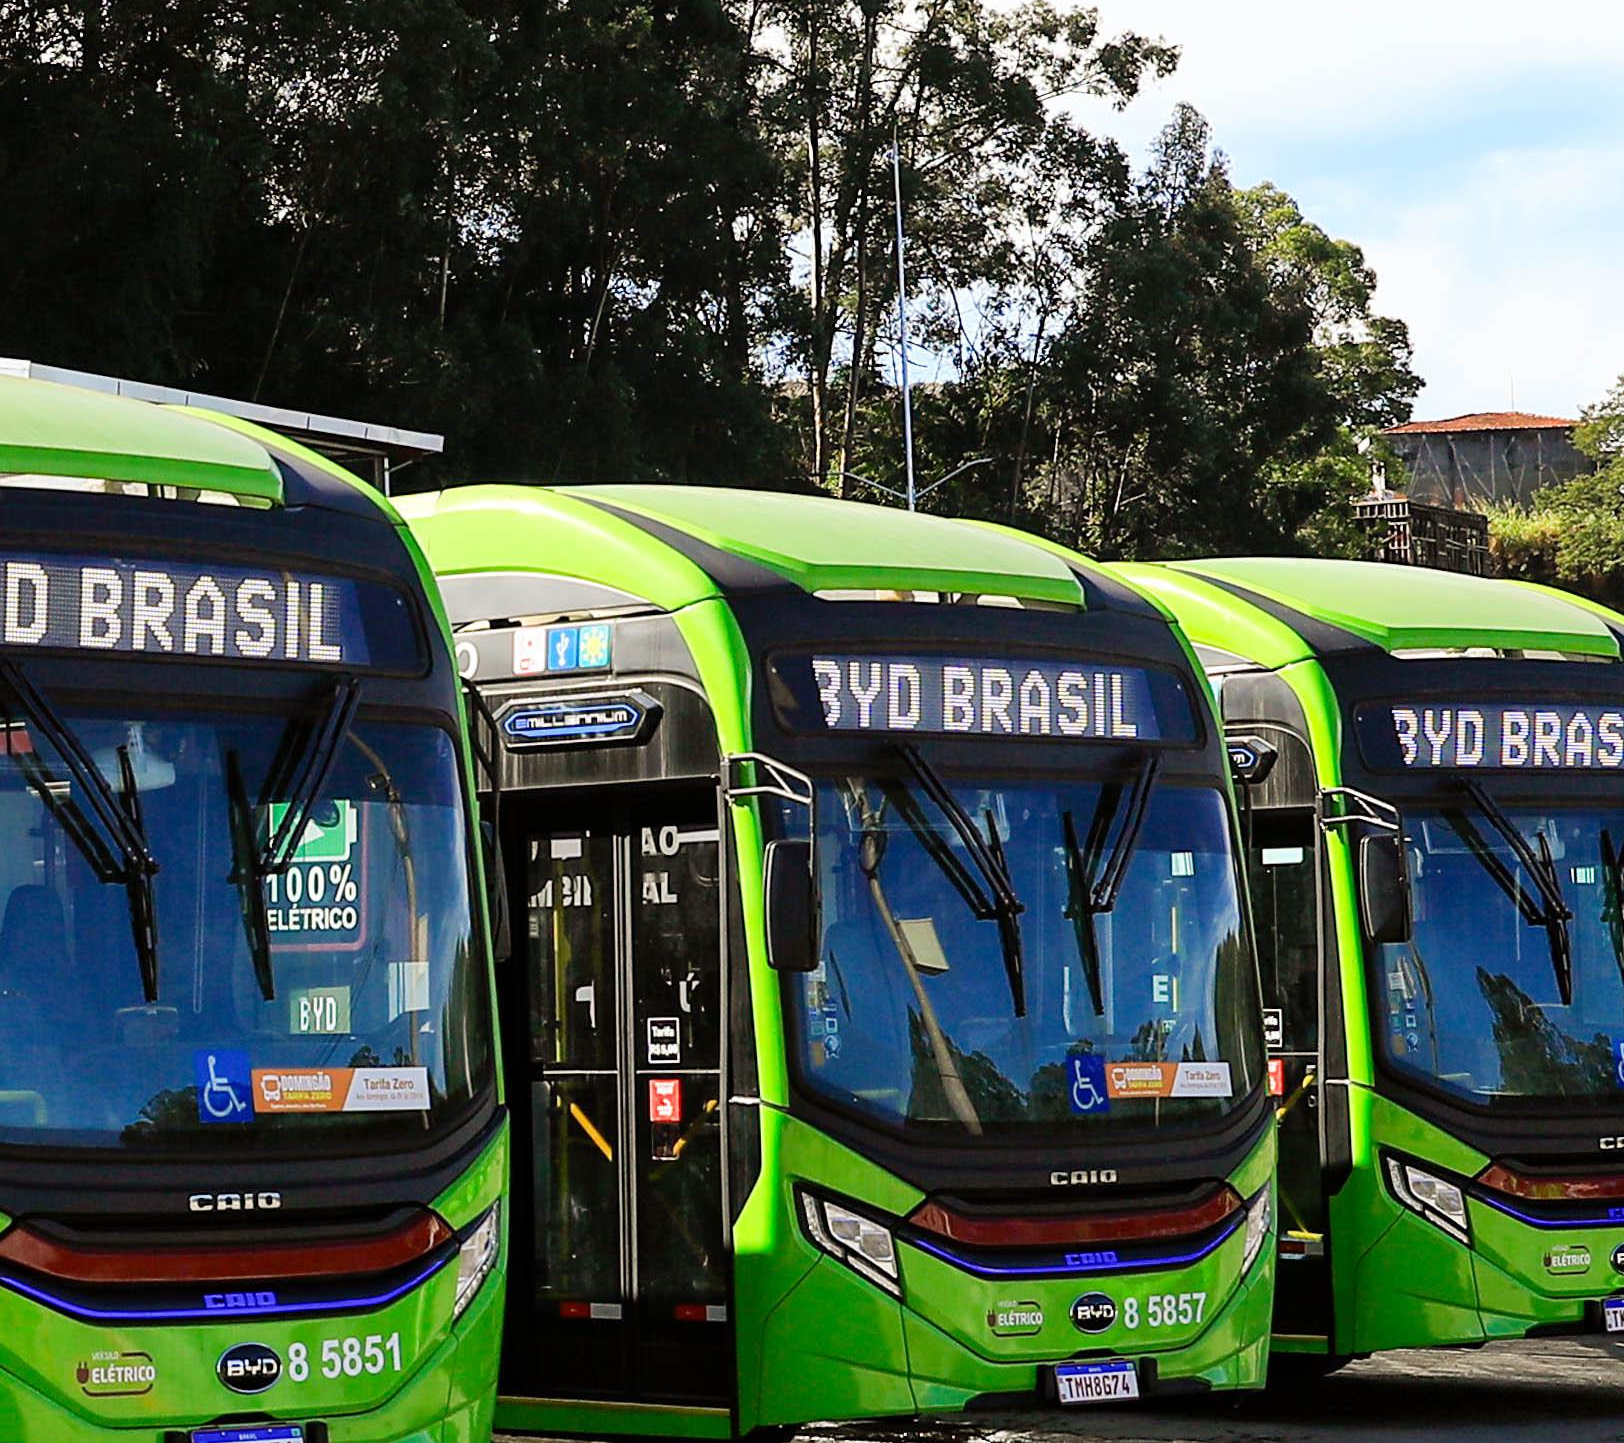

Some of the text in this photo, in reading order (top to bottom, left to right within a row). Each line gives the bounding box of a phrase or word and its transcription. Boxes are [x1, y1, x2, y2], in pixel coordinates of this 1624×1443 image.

[78, 566, 342, 661] BRASIL
[812, 659, 1138, 737] BYD BRASIL
[266, 863, 357, 902] 100%
[267, 904, 357, 931] ELÉTRICO
[300, 997, 337, 1032] BYD
[363, 1078, 414, 1091] Tarifa Zero
[1050, 1169, 1118, 1186] CAIO
[189, 1191, 282, 1212] CAIO
[1552, 1251, 1591, 1267] ELÉTRICO
[204, 1291, 277, 1309] CAIO
[1124, 1292, 1206, 1329] 8 5857
[998, 1307, 1043, 1326] ELÉTRICO
[1077, 1304, 1115, 1320] BYD
[226, 1358, 279, 1377] BYD
[288, 1331, 402, 1383] 8 5851
[91, 1363, 156, 1385] ELÉTRICO
[1065, 1374, 1130, 1399] TMH8G74
